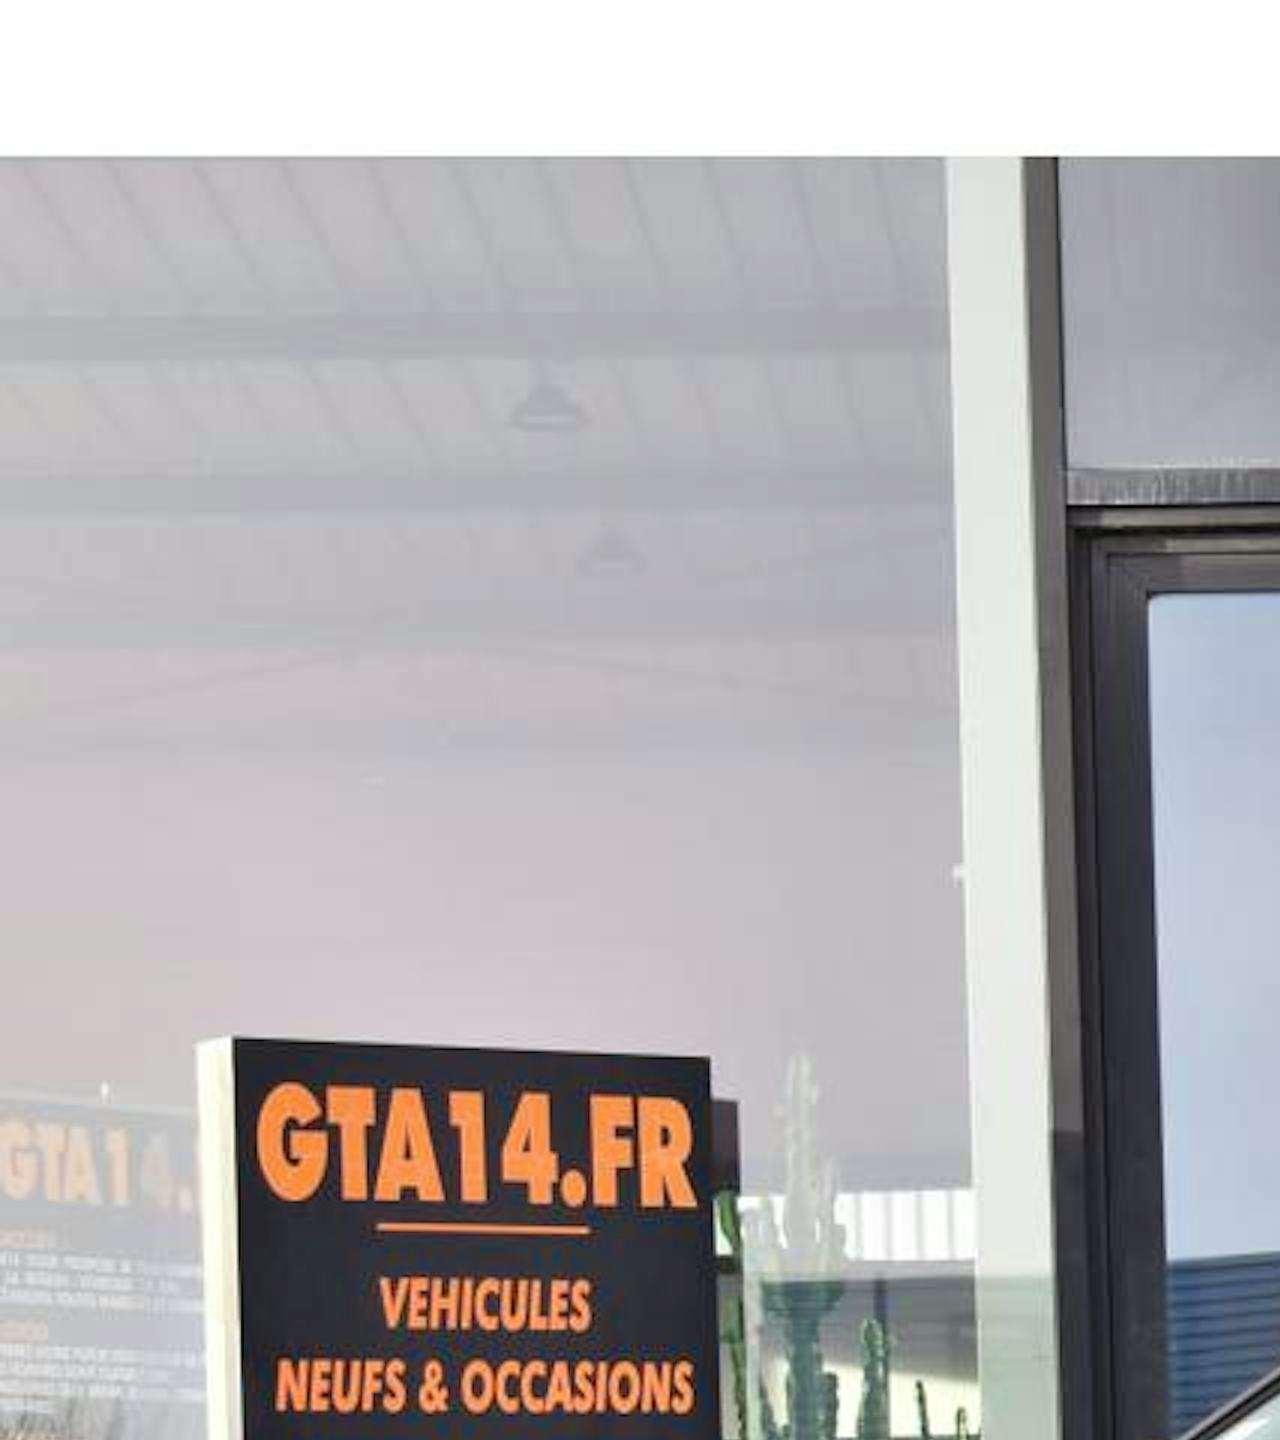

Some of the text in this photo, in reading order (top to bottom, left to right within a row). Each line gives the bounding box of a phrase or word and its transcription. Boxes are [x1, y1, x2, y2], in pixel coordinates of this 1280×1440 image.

[256, 1081, 697, 1210] GTA14.FR
[381, 1276, 593, 1334] VEHICULES
[276, 1357, 695, 1416] NEUFS & OCCASIONS
